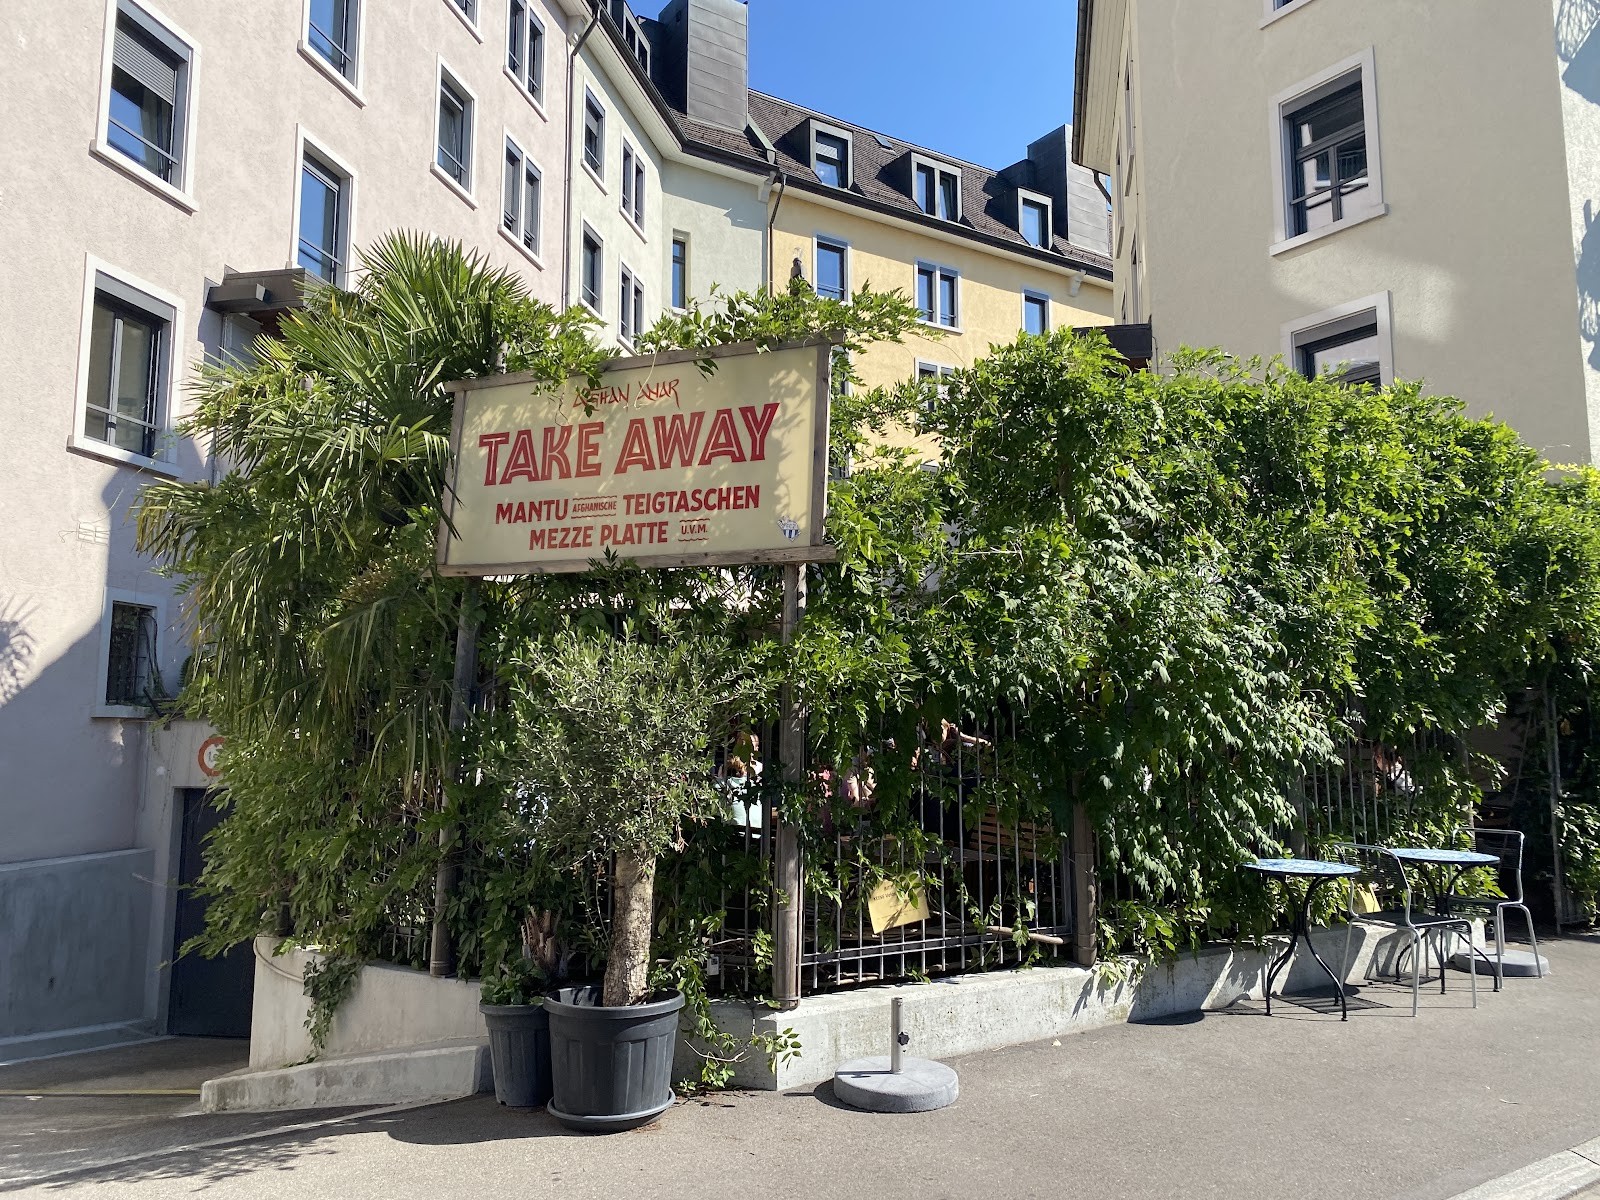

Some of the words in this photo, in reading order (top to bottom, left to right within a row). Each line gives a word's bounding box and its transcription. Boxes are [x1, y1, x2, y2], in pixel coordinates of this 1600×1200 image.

[478, 421, 605, 486] TAKE
[613, 402, 781, 475] AWAY
[495, 498, 569, 524] MANTU
[572, 500, 617, 513] AFGHANISCHE
[622, 484, 760, 516] TEIGTASCHEN
[529, 525, 594, 550] MEZZE
[600, 521, 669, 546] PLATTE
[681, 523, 708, 535] U.V.M.
